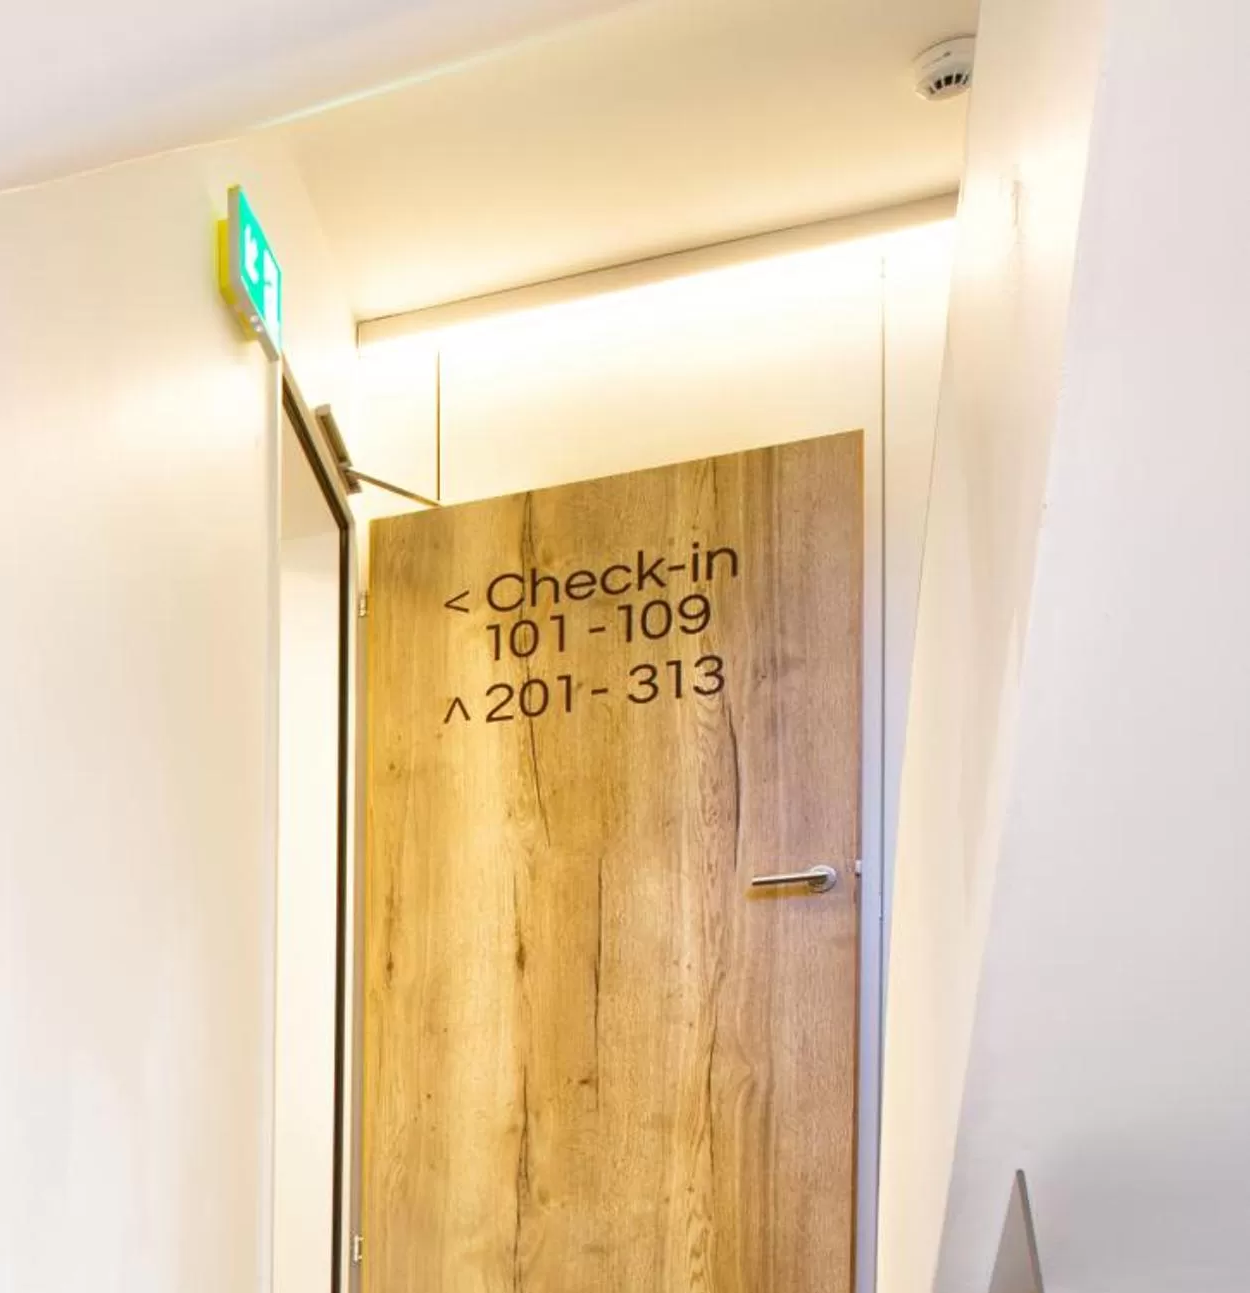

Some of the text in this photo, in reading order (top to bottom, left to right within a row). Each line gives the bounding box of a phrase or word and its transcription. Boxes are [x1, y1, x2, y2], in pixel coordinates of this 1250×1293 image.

[485, 541, 740, 613] Check-in
[485, 613, 566, 661] 101
[616, 593, 712, 643] 109
[485, 674, 573, 723] 201
[627, 654, 726, 705] 313
